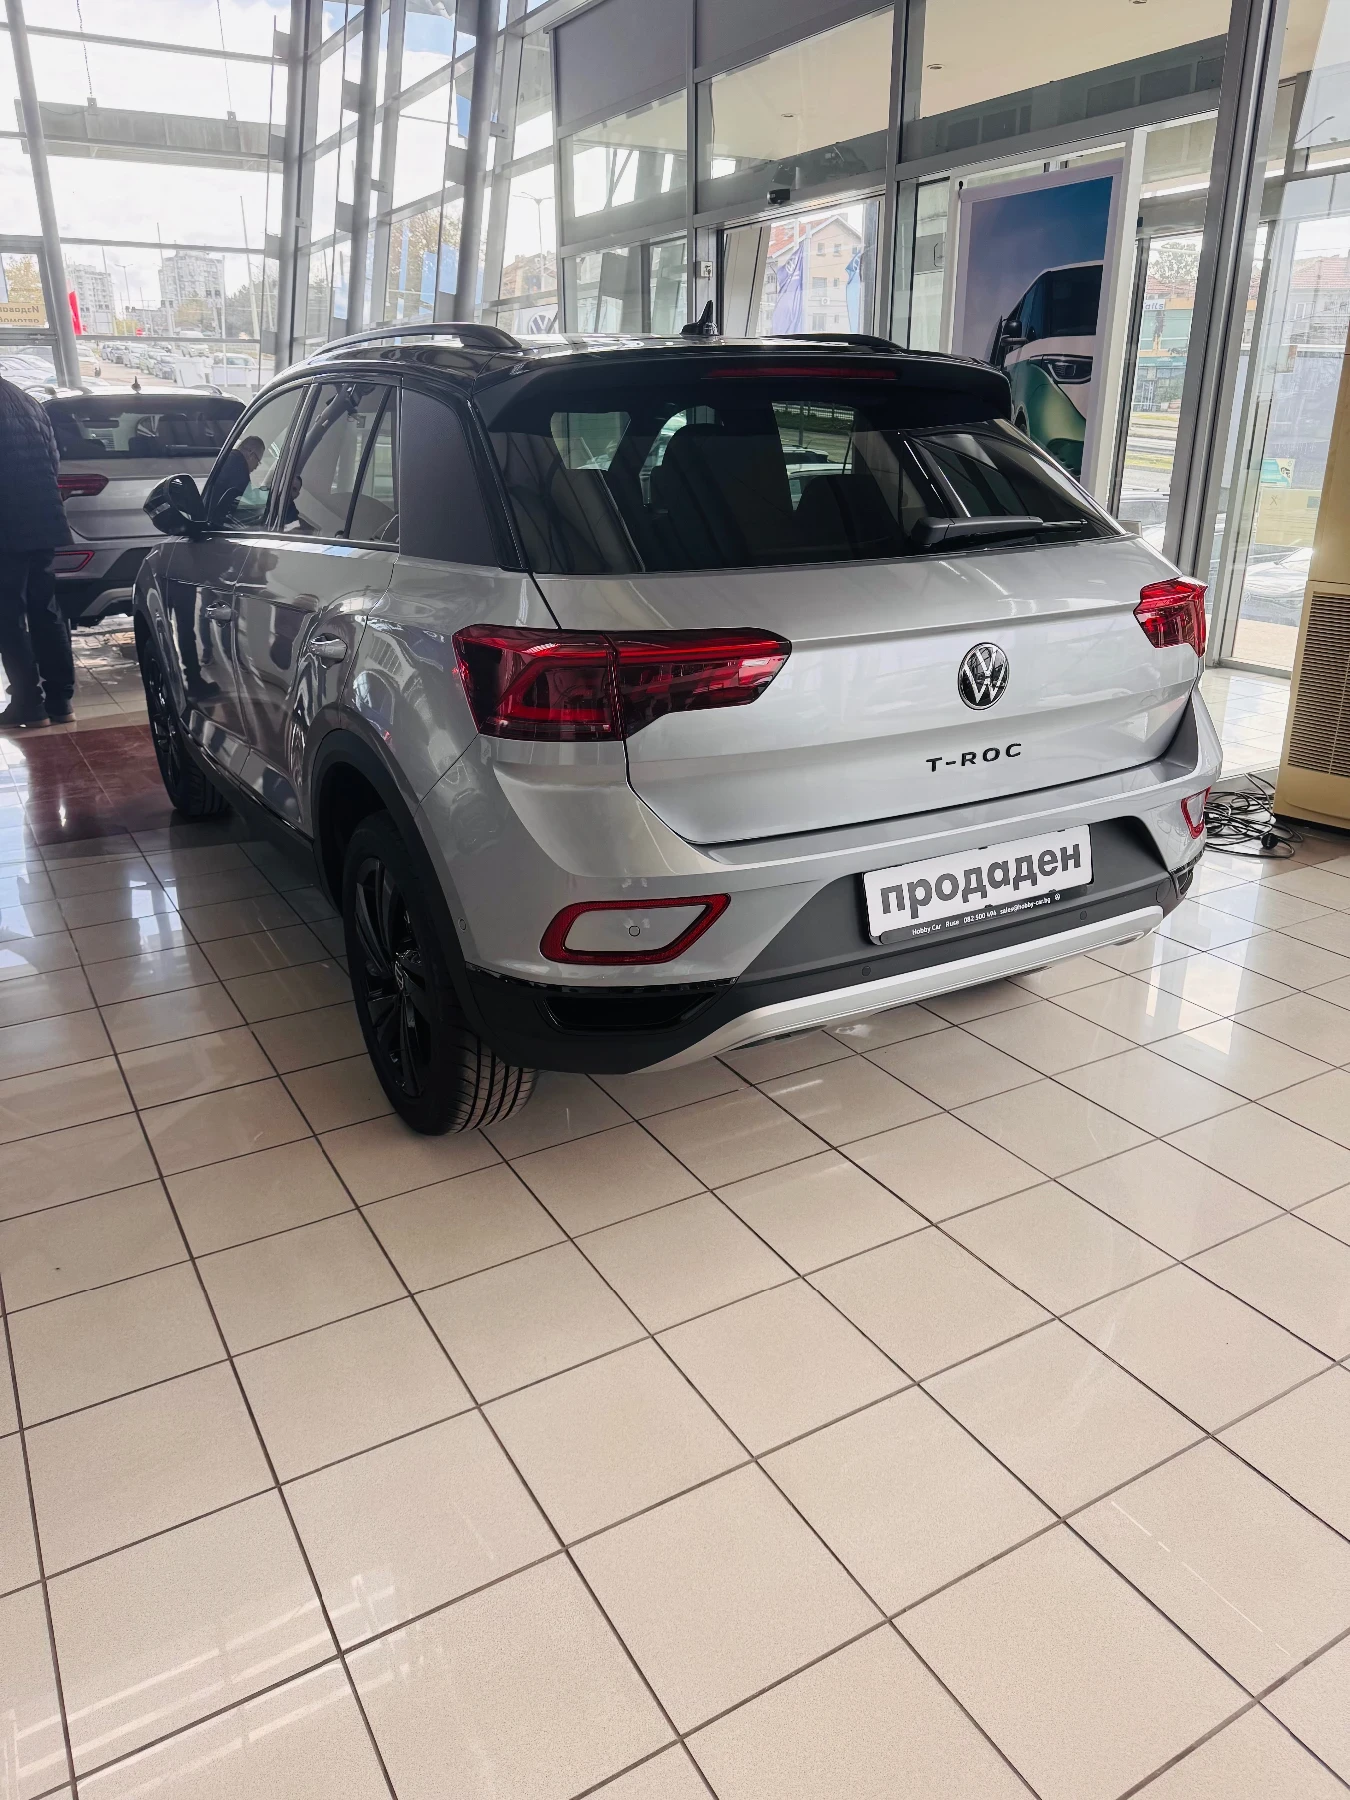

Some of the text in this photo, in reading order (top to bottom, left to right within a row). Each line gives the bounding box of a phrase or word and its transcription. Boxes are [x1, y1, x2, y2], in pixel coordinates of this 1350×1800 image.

[1144, 302, 1164, 310] ails
[925, 742, 1022, 773] T-ROC
[880, 843, 1082, 920] продаден
[912, 926, 931, 936] Hobby
[931, 923, 942, 931] Car
[945, 919, 960, 928] Ruse
[975, 912, 986, 921] 500
